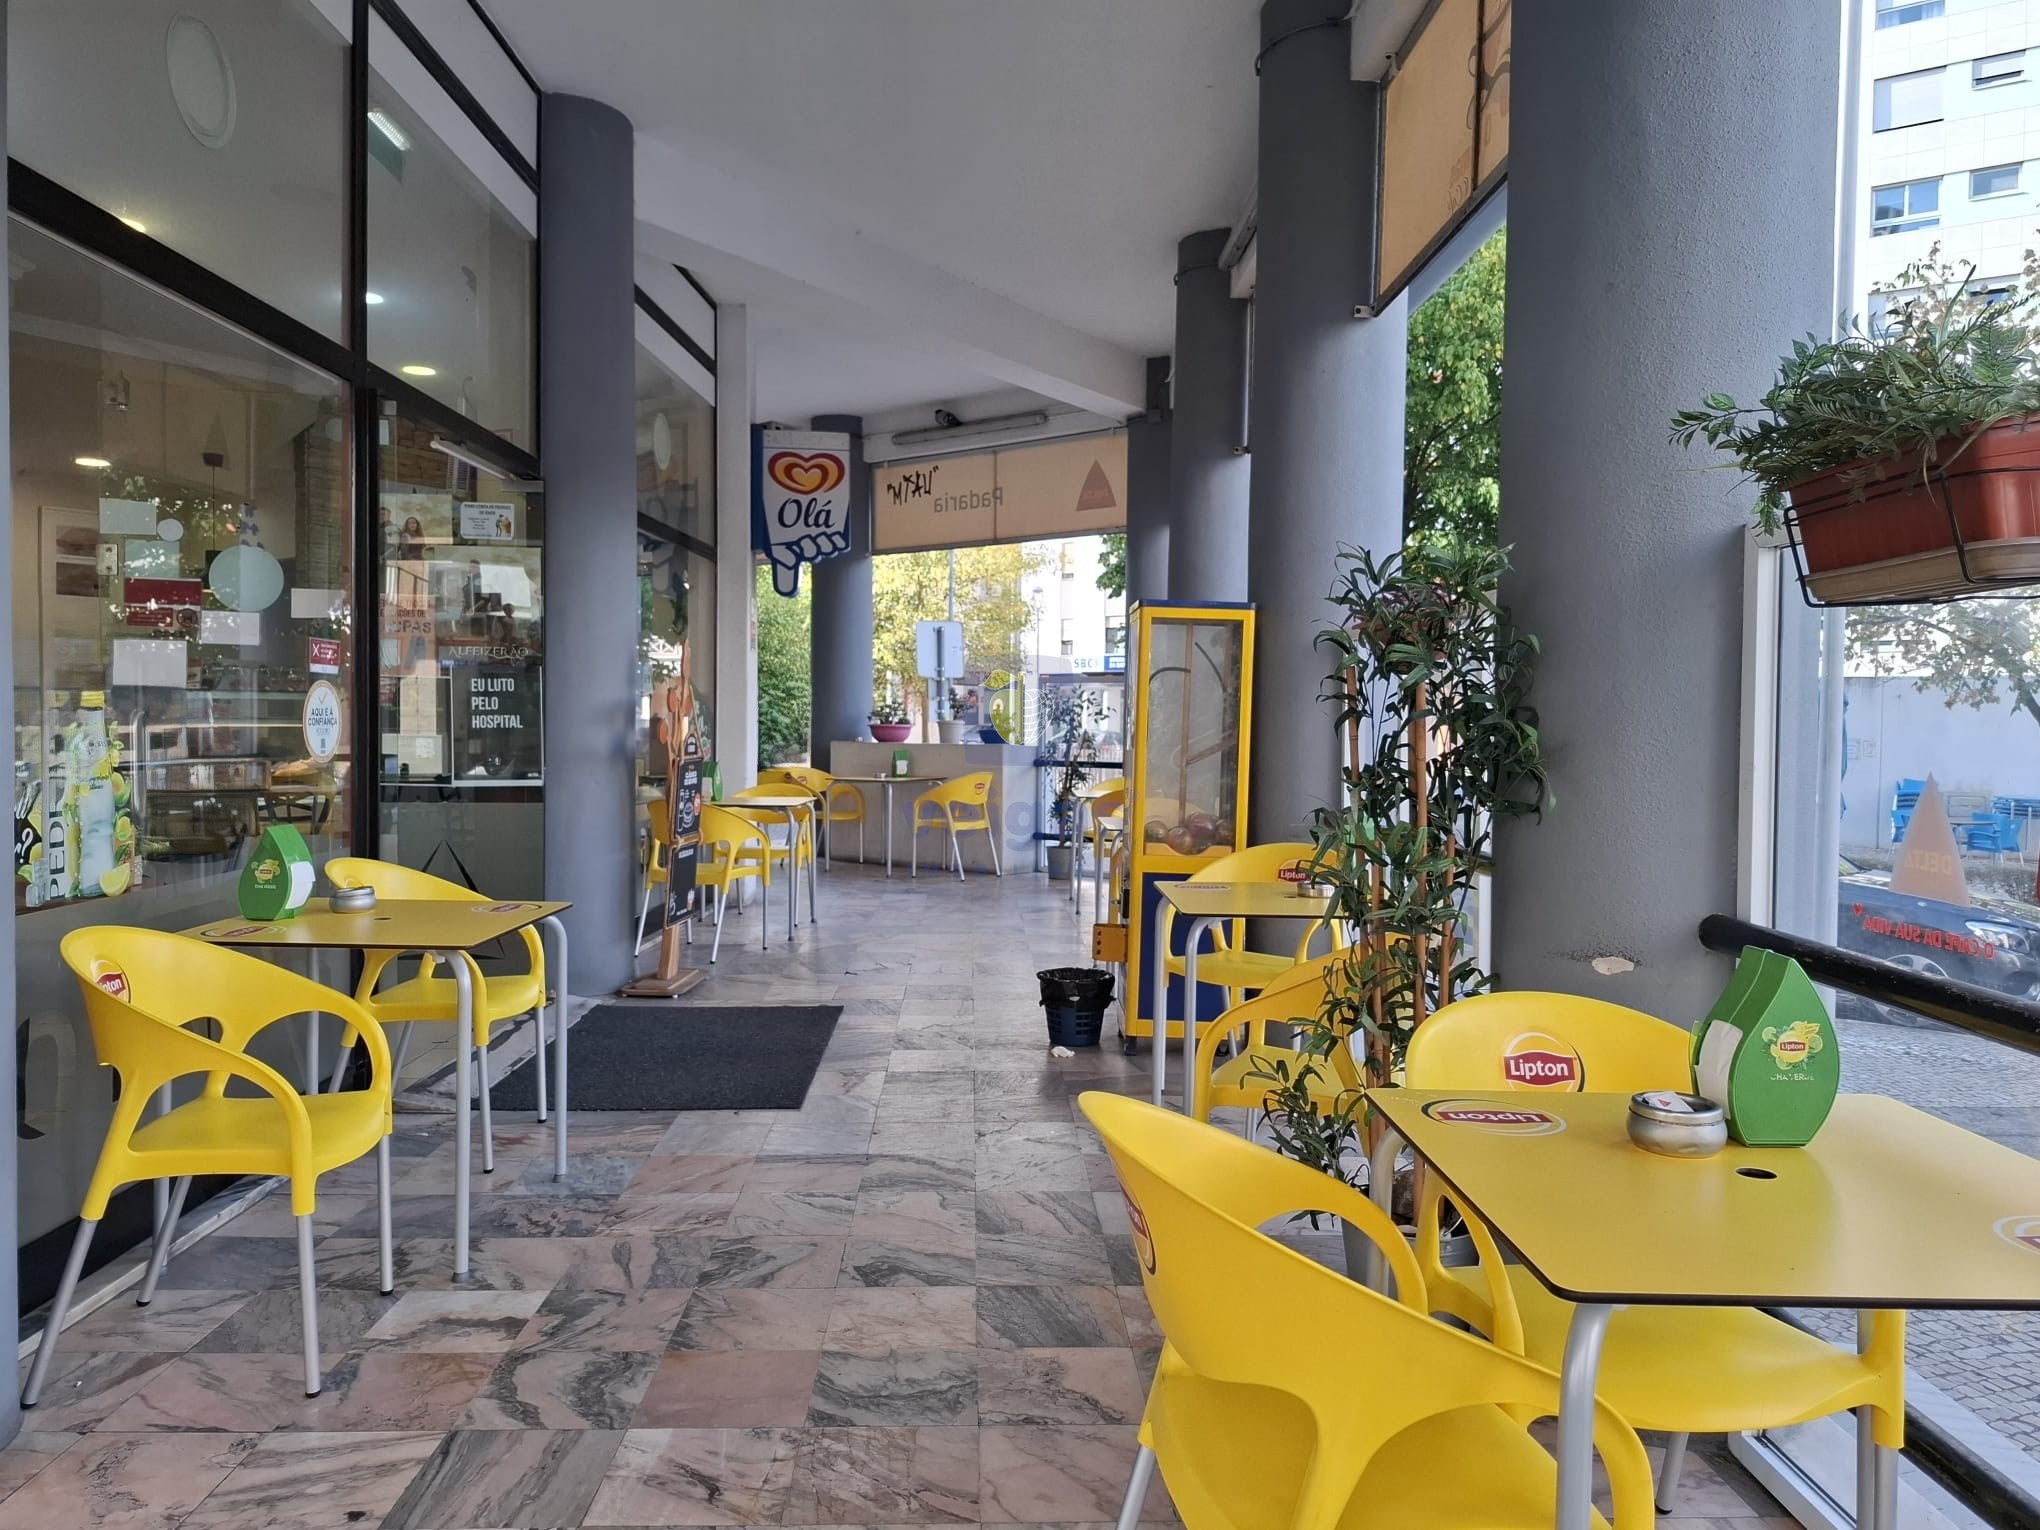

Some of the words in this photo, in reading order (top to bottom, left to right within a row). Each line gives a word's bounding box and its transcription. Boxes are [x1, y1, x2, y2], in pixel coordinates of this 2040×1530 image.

[777, 498, 836, 529] Olá
[471, 678, 485, 692] EU
[488, 678, 515, 692] LUTO
[471, 696, 499, 710] PELO
[308, 717, 338, 728] CONFIANÇA
[472, 714, 523, 728] HOSPITAL
[1280, 870, 1306, 881] Lipton
[99, 978, 122, 993] pton
[1781, 1043, 1804, 1051] Lipton
[1509, 1059, 1569, 1080] Lipton
[1448, 1112, 1543, 1123] Lipton
